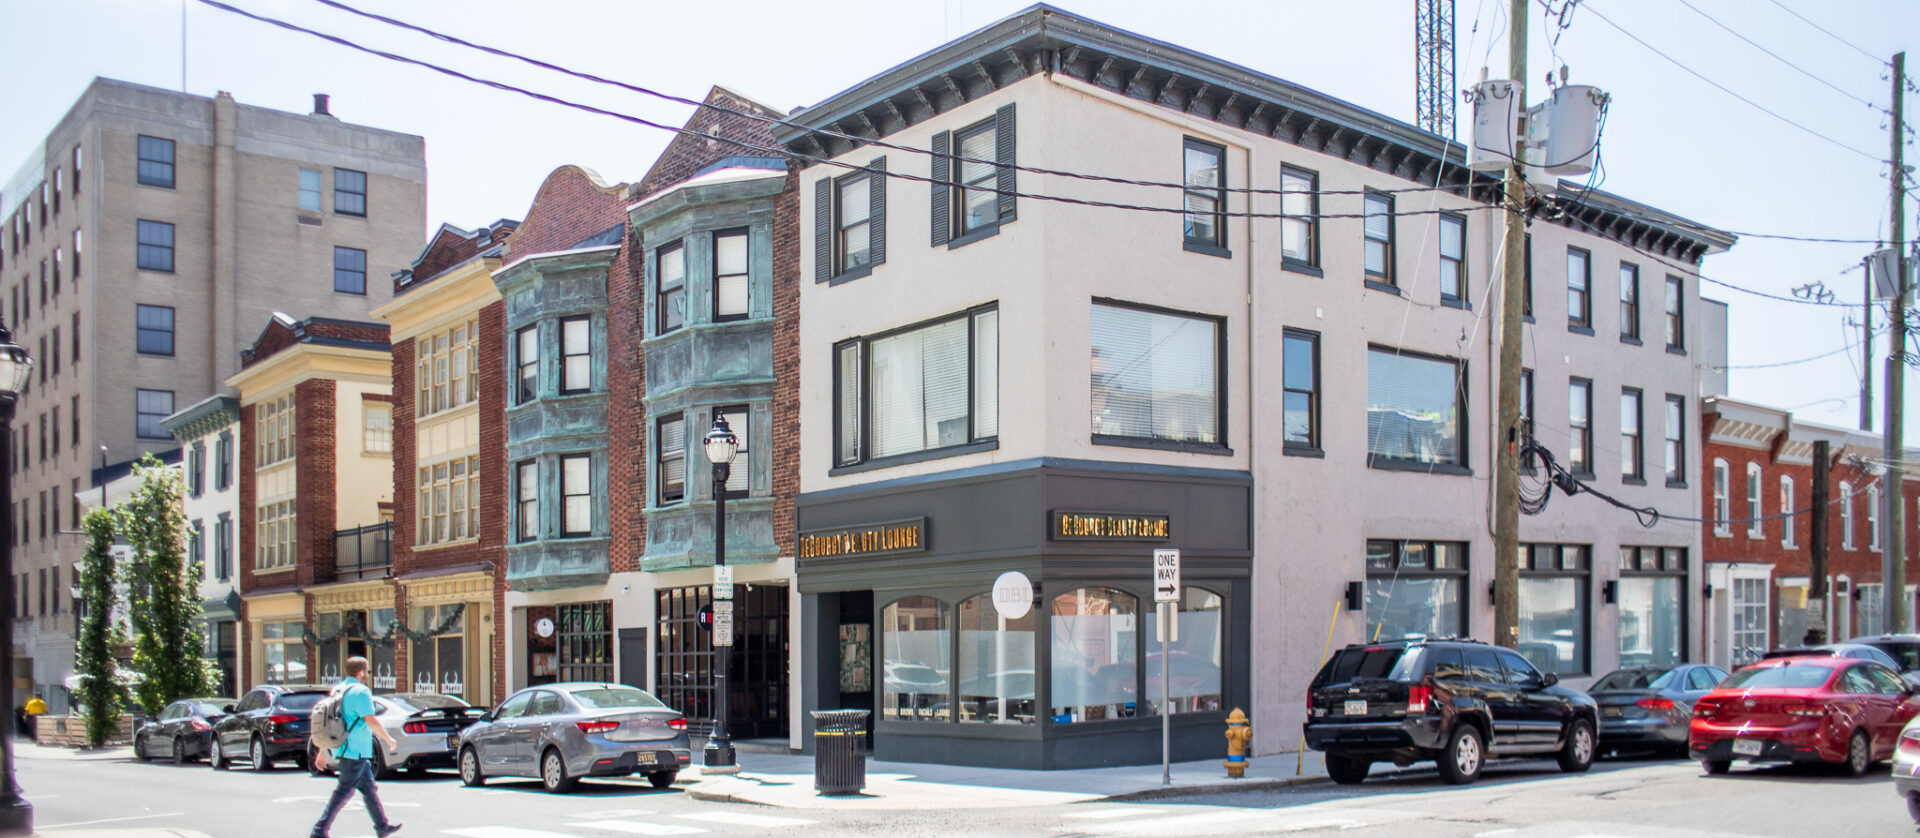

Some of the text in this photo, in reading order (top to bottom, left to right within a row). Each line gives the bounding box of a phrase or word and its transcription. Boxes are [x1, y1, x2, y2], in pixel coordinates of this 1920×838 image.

[843, 531, 879, 554] BEUTY
[882, 526, 918, 550] LOUNGE
[1158, 555, 1176, 566] ONE
[1158, 569, 1176, 580] WAY
